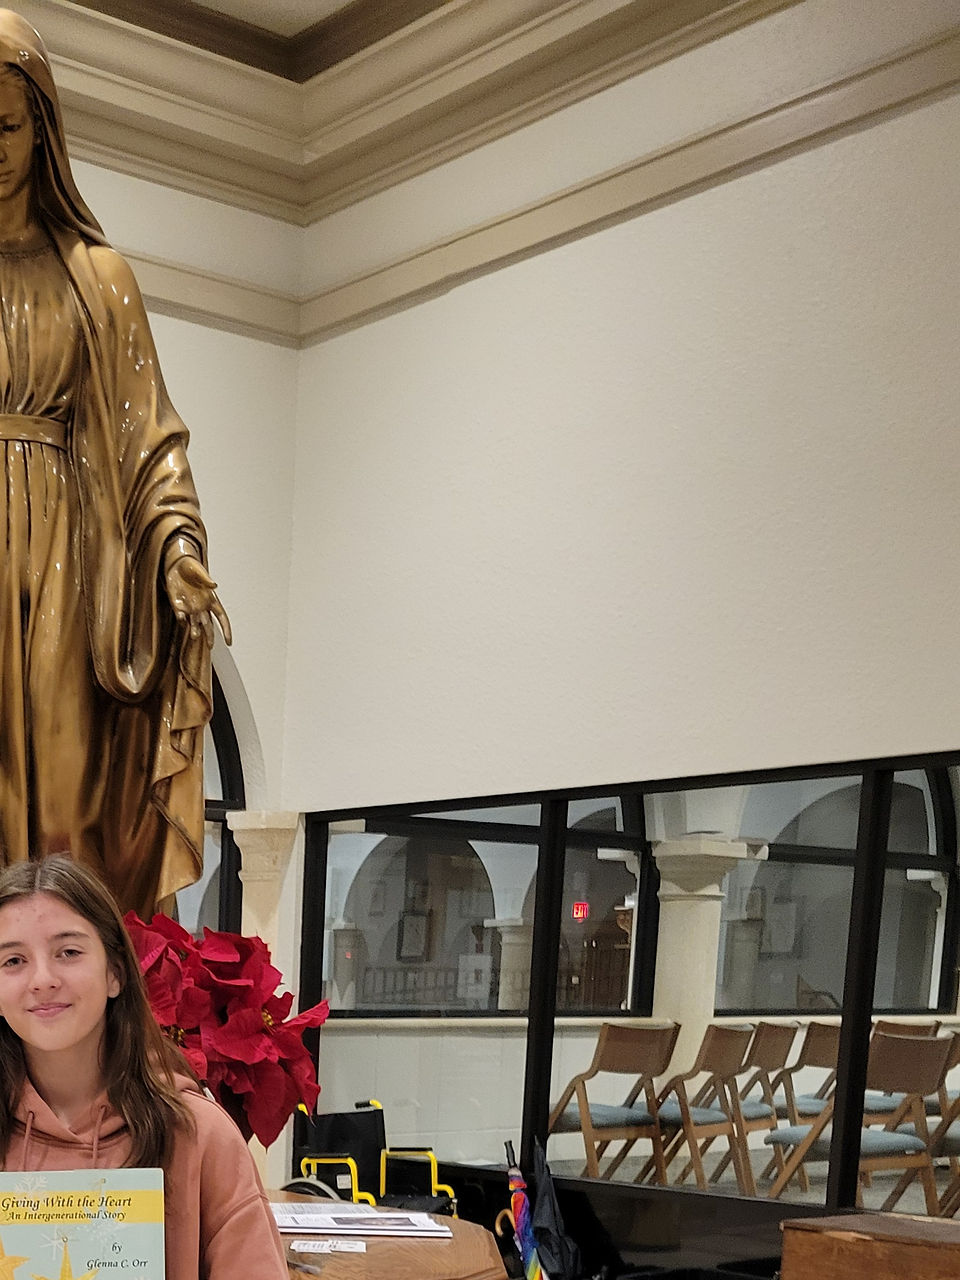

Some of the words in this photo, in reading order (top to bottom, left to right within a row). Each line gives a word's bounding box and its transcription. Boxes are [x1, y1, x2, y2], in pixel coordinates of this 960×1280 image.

[1, 1197, 40, 1211] Giving
[43, 1195, 74, 1207] With
[77, 1195, 95, 1207] the
[97, 1196, 132, 1207] Heart
[6, 1211, 21, 1221] An
[23, 1210, 100, 1222] Intergenerational
[102, 1210, 127, 1222] Story
[112, 1242, 123, 1254] by
[86, 1259, 118, 1270] Glenna
[120, 1259, 129, 1268] C.
[132, 1259, 148, 1268] Orr
